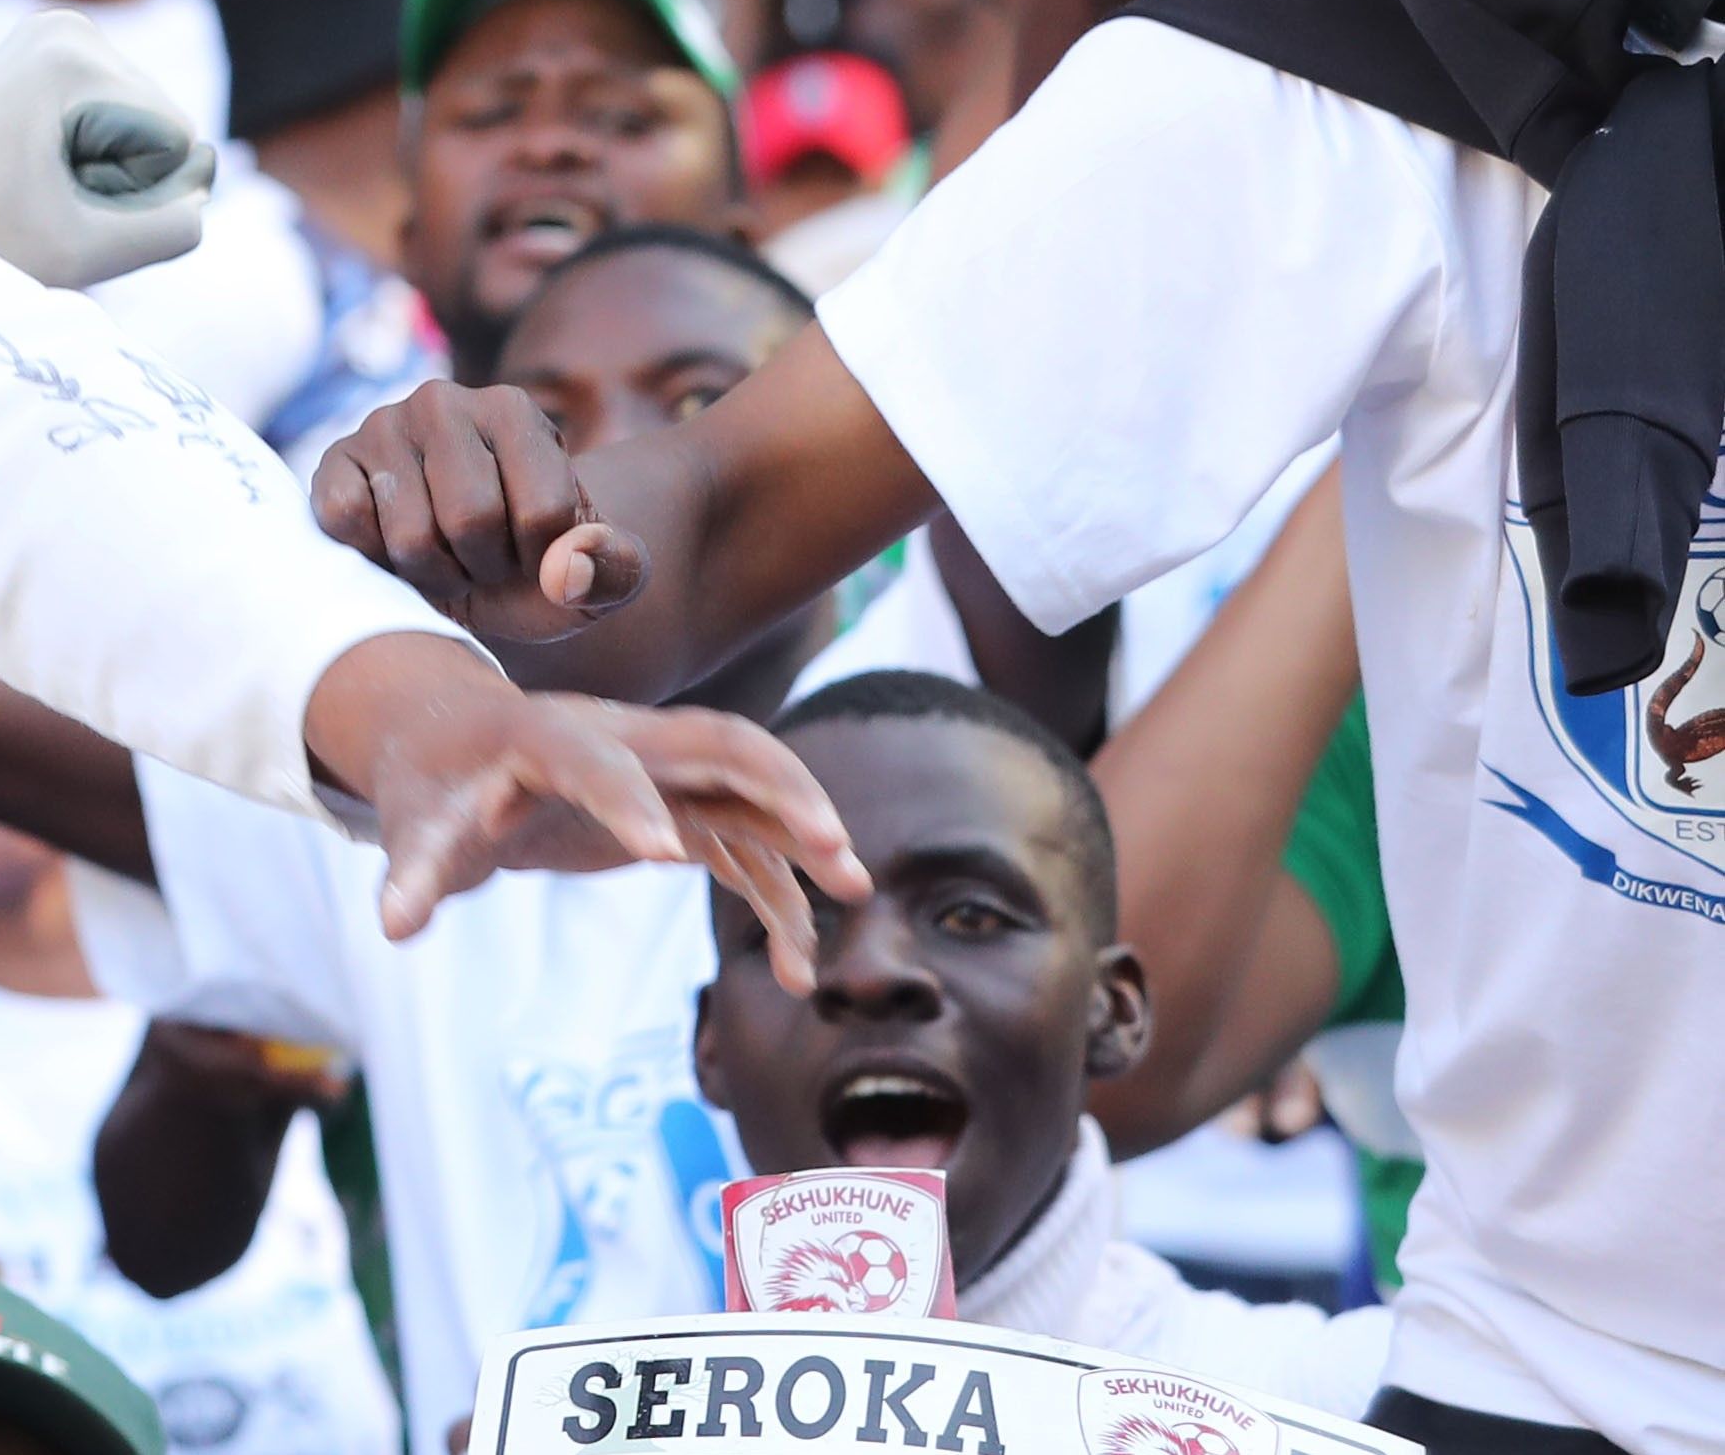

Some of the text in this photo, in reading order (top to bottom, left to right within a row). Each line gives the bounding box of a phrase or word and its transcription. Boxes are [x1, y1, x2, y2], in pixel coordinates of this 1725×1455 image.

[1612, 871, 1725, 921] DIKWENA
[760, 1185, 915, 1226] SEKHUKHUNE
[811, 1211, 863, 1226] UNITED
[562, 1353, 1006, 1454] SEROKA
[1103, 1377, 1256, 1432] SEKHUKHUNE
[1153, 1398, 1205, 1420] UNITED
